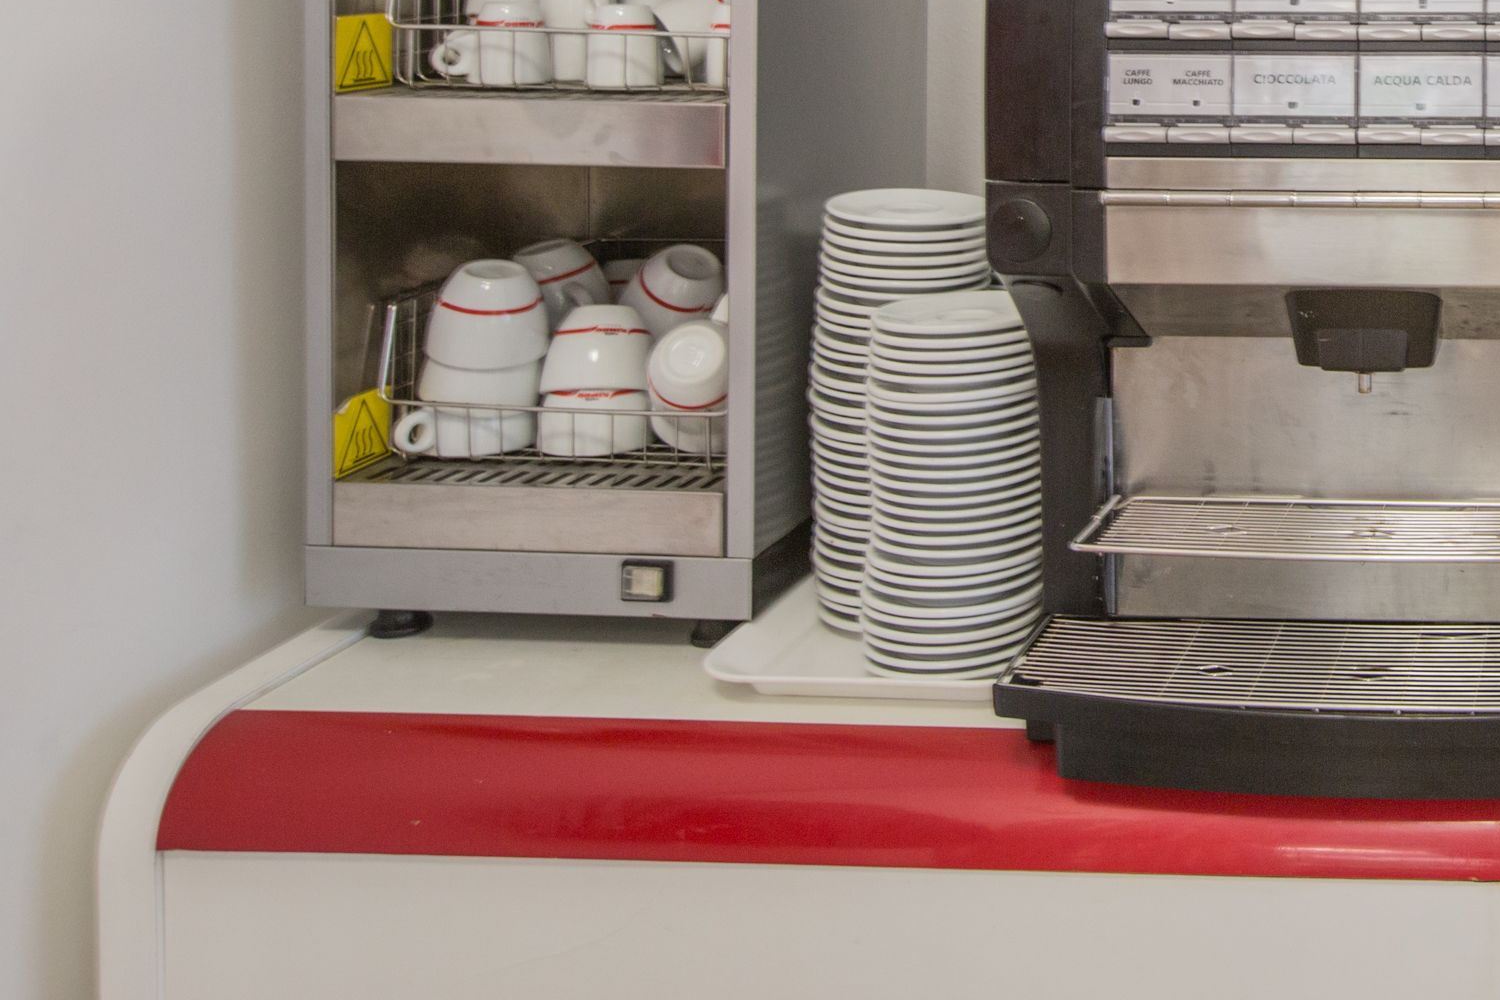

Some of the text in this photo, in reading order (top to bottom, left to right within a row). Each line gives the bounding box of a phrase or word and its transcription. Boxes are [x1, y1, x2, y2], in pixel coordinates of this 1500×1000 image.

[1253, 74, 1337, 85] CIOCCOLATA
[1374, 75, 1473, 87] ACQUA CALDA
